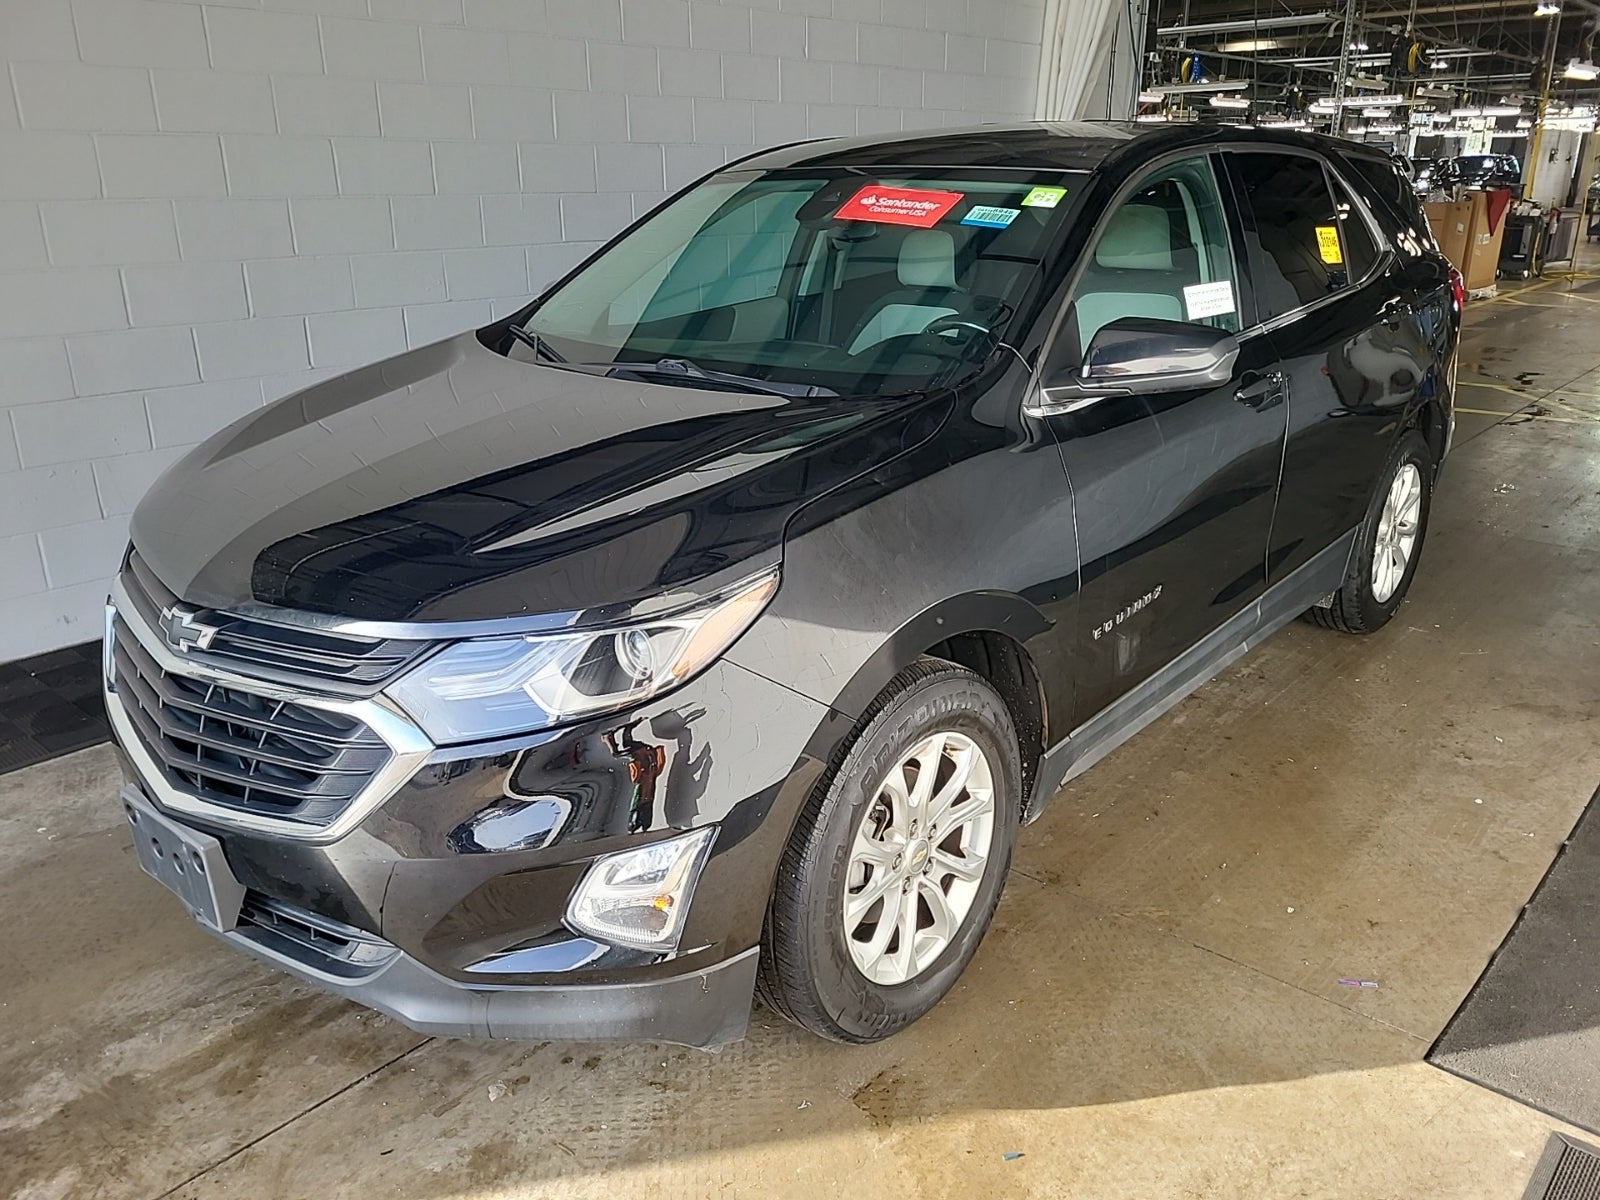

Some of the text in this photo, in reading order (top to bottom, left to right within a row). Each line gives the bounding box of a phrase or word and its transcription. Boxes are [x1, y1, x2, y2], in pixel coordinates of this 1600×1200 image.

[868, 204, 928, 218] Consumer USA
[875, 196, 942, 212] Santander
[1092, 584, 1163, 641] EQUINOX
